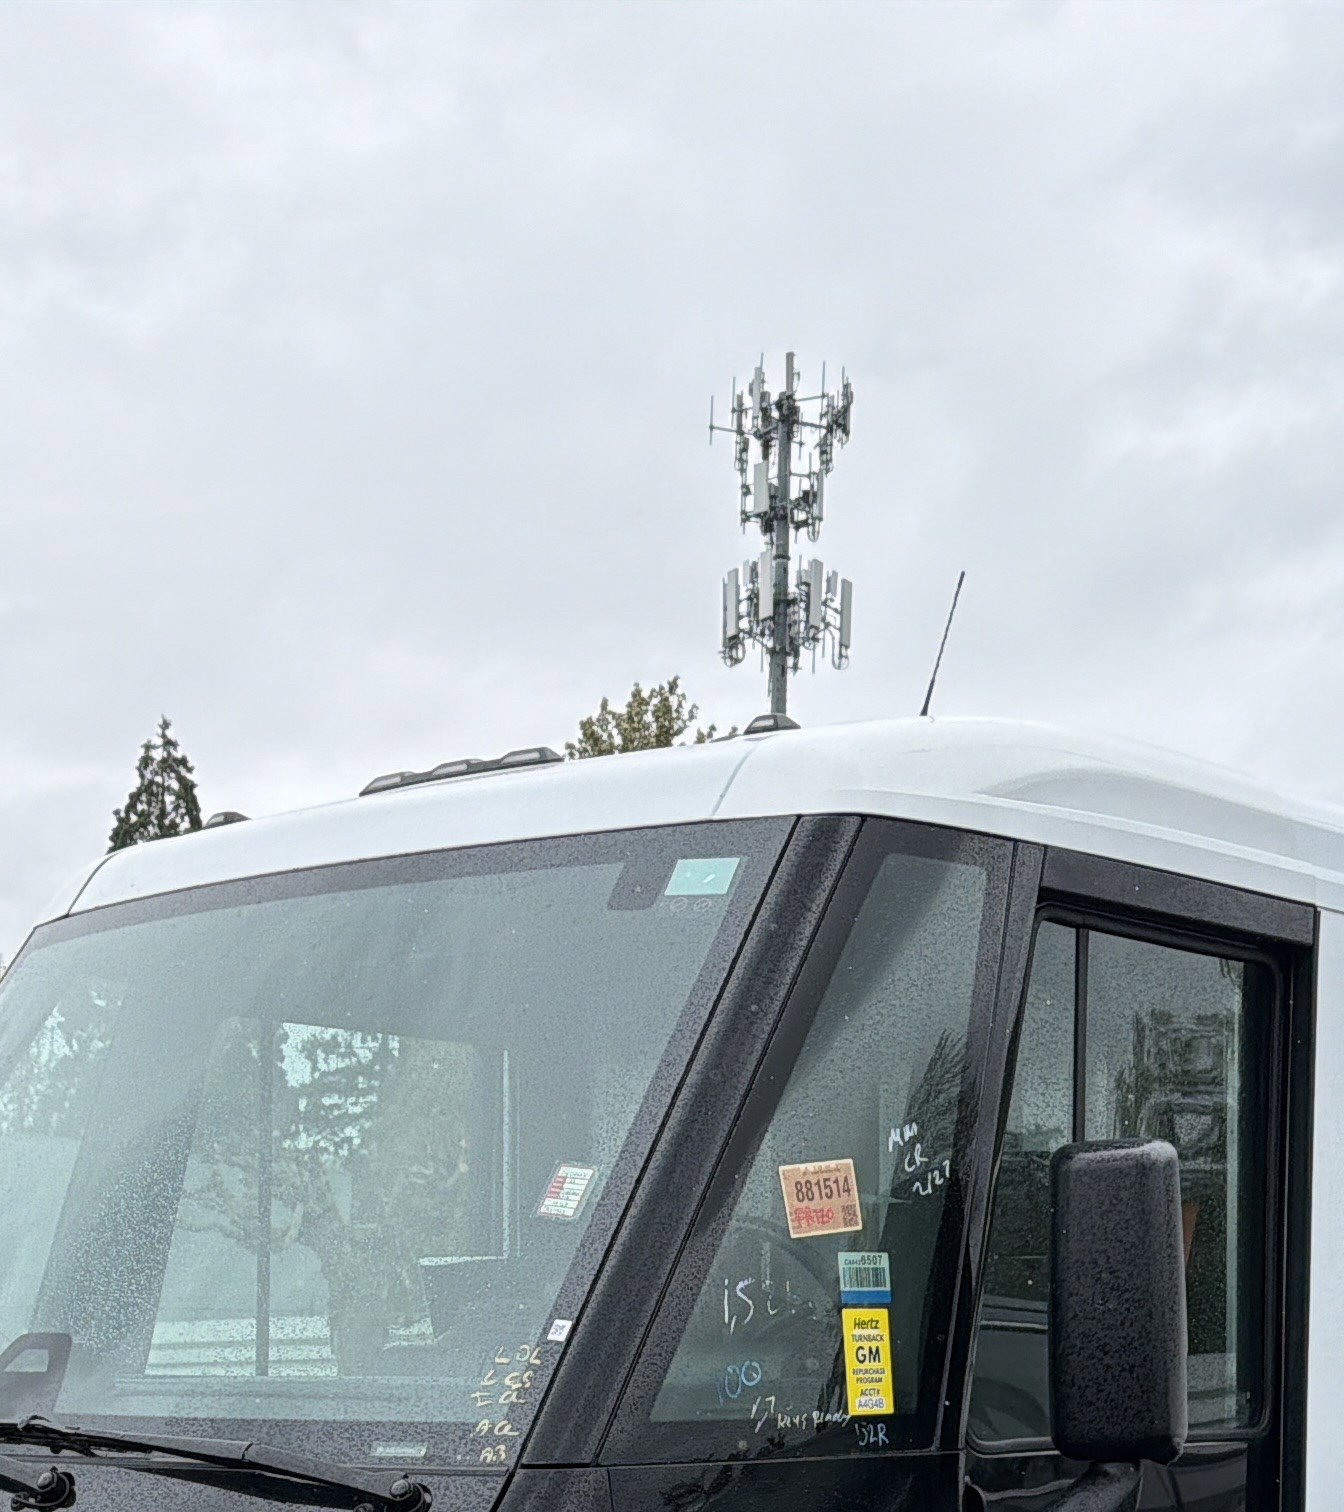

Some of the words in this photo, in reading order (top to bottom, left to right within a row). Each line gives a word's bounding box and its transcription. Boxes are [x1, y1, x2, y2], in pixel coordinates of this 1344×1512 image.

[794, 1175, 851, 1203] 881514
[853, 1317, 880, 1330] Hertz
[851, 1333, 885, 1342] TURNBACK
[856, 1345, 881, 1364] GM
[852, 1367, 886, 1376] REPURCHASE
[856, 1376, 883, 1385] PROGRAM
